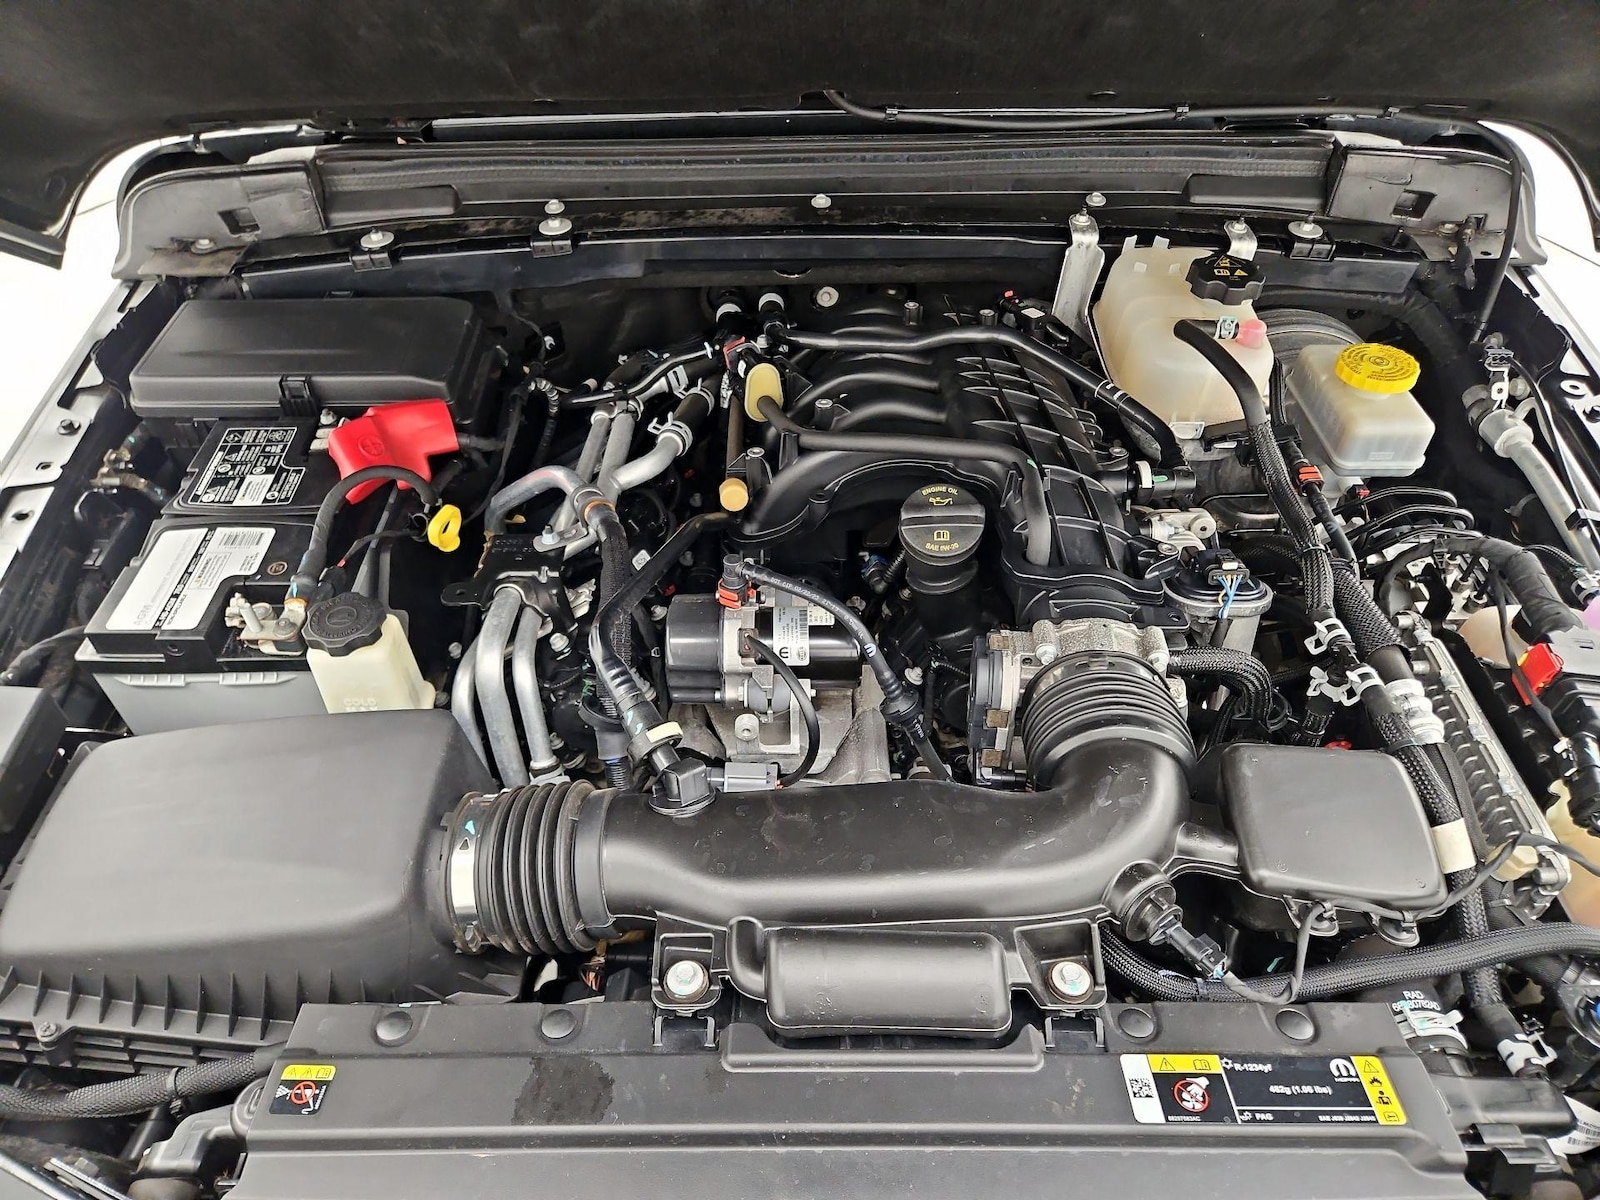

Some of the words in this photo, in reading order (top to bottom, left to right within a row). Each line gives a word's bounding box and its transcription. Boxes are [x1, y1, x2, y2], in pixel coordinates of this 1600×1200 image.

[922, 486, 947, 496] ENGINE
[947, 487, 959, 496] OIL
[925, 542, 939, 552] SAE
[939, 542, 959, 552] 0W-20
[343, 698, 378, 706] COLD
[1402, 990, 1425, 1000] RAD
[1233, 1063, 1273, 1073] R-1234yf
[1313, 1085, 1333, 1095] lbs)
[1255, 1112, 1274, 1121] PAG
